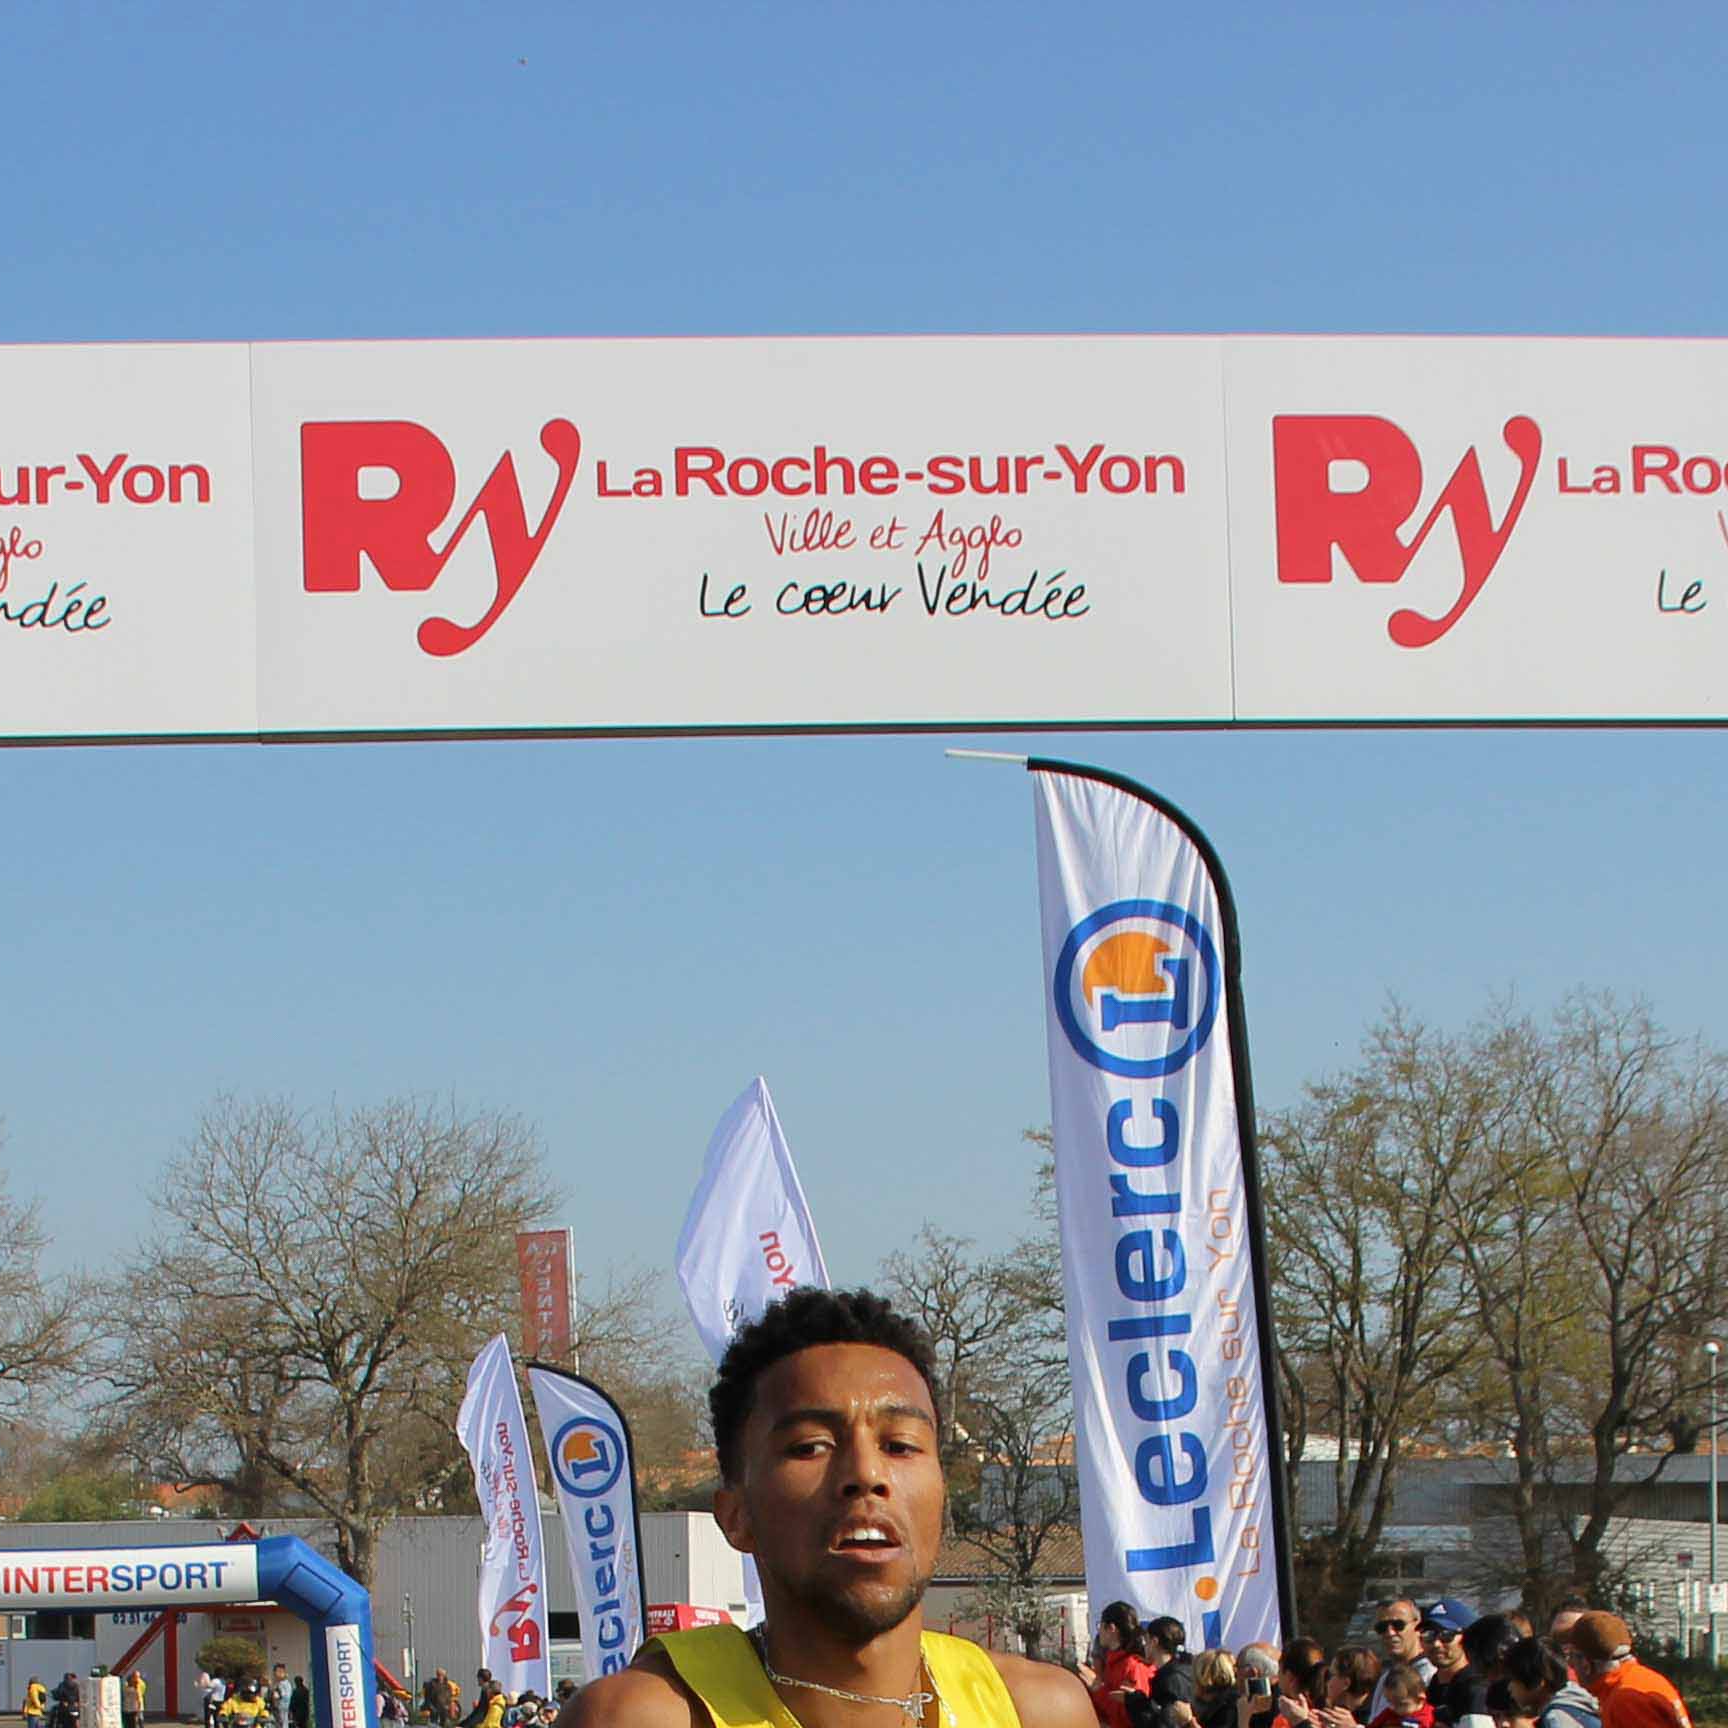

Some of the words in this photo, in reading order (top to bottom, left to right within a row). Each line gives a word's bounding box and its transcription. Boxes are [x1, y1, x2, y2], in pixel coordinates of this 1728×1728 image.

[596, 460, 663, 498] La
[674, 444, 1186, 498] Roche-sur-Yon
[1557, 455, 1622, 496] La
[764, 511, 858, 555] Ville
[869, 520, 905, 550] et
[914, 509, 1024, 578] Agglo
[699, 573, 752, 619] Le
[775, 581, 903, 617] cœur
[916, 562, 1091, 620] Vendée
[1656, 569, 1709, 615] Le
[1205, 1189, 1233, 1271] Yon
[1216, 1289, 1242, 1359] sur
[1223, 1378, 1256, 1510] Roche
[3, 1561, 228, 1594] INTERSPORT
[1236, 1526, 1260, 1577] La
